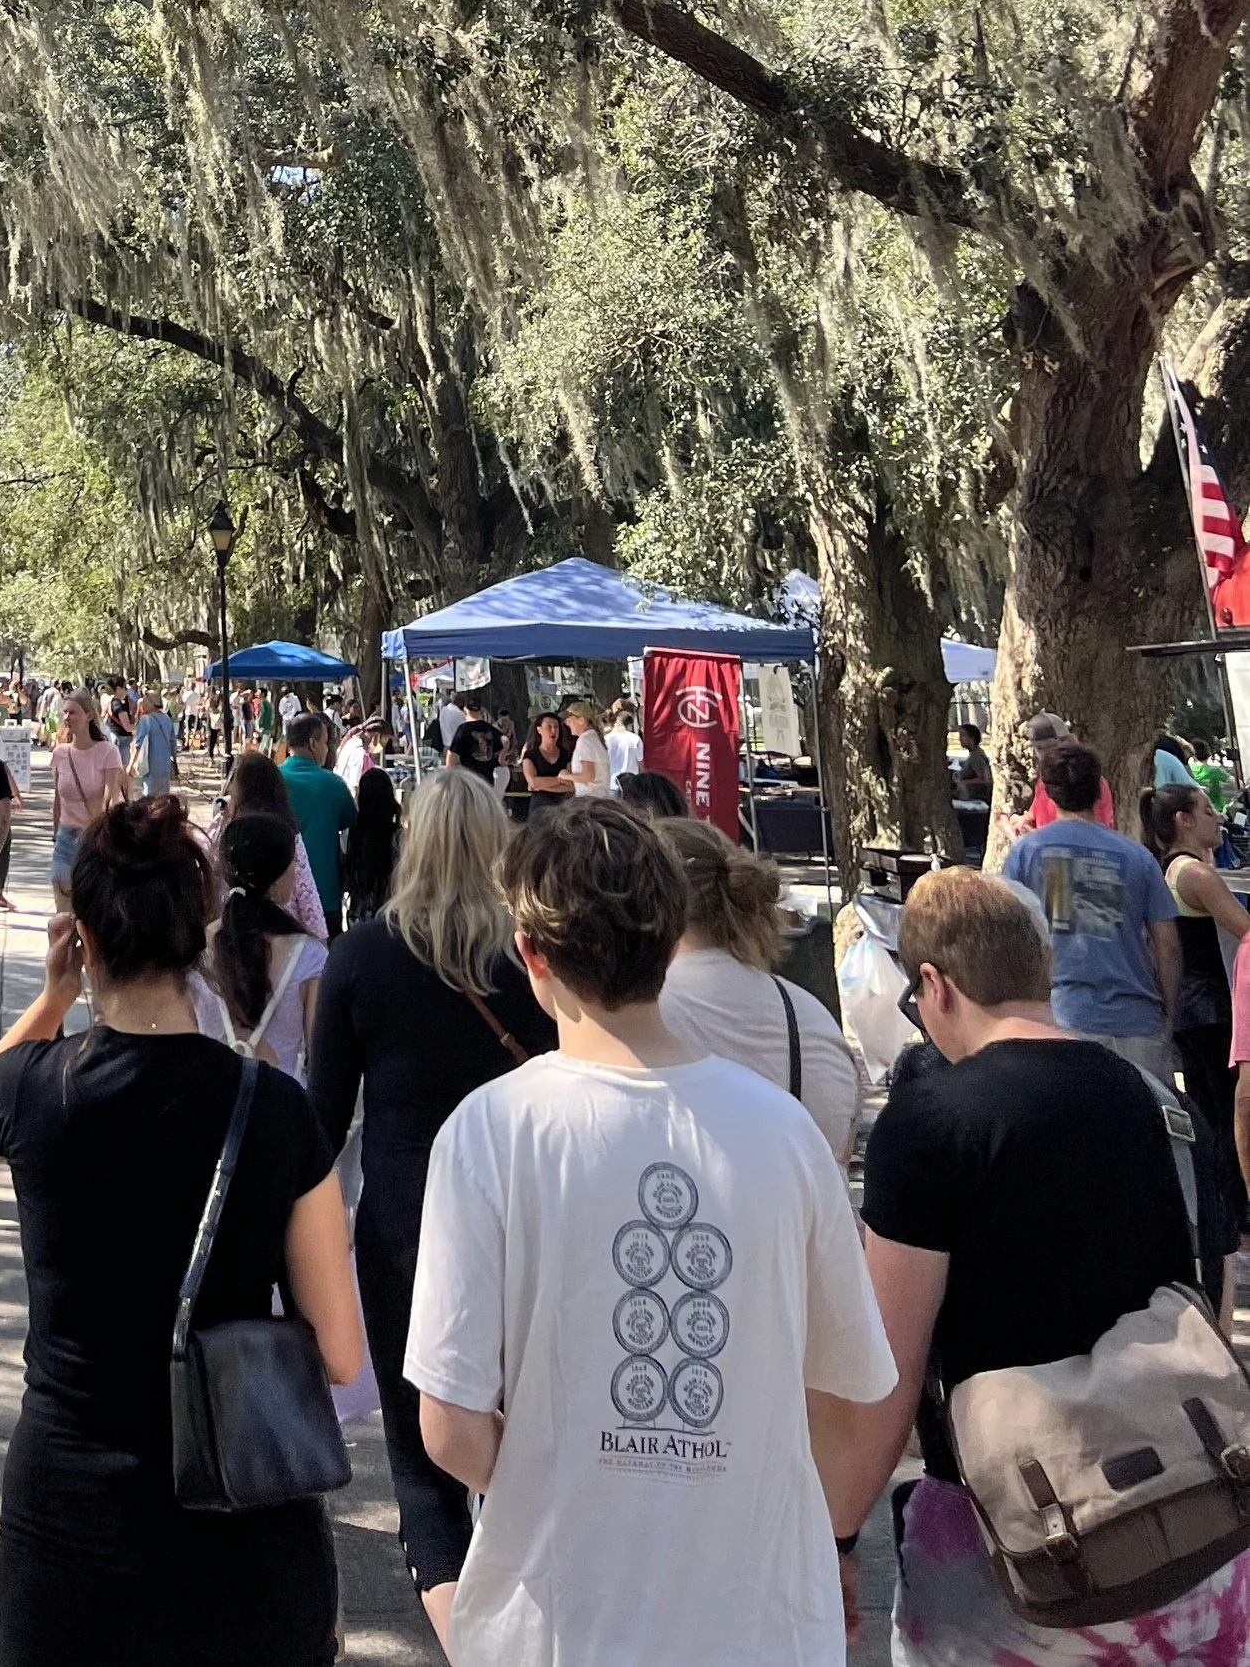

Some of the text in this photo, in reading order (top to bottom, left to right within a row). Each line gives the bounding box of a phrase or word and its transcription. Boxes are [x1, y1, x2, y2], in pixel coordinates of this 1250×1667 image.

[696, 742, 711, 808] NINE
[599, 1431, 727, 1459] BLAIR ATHOL
